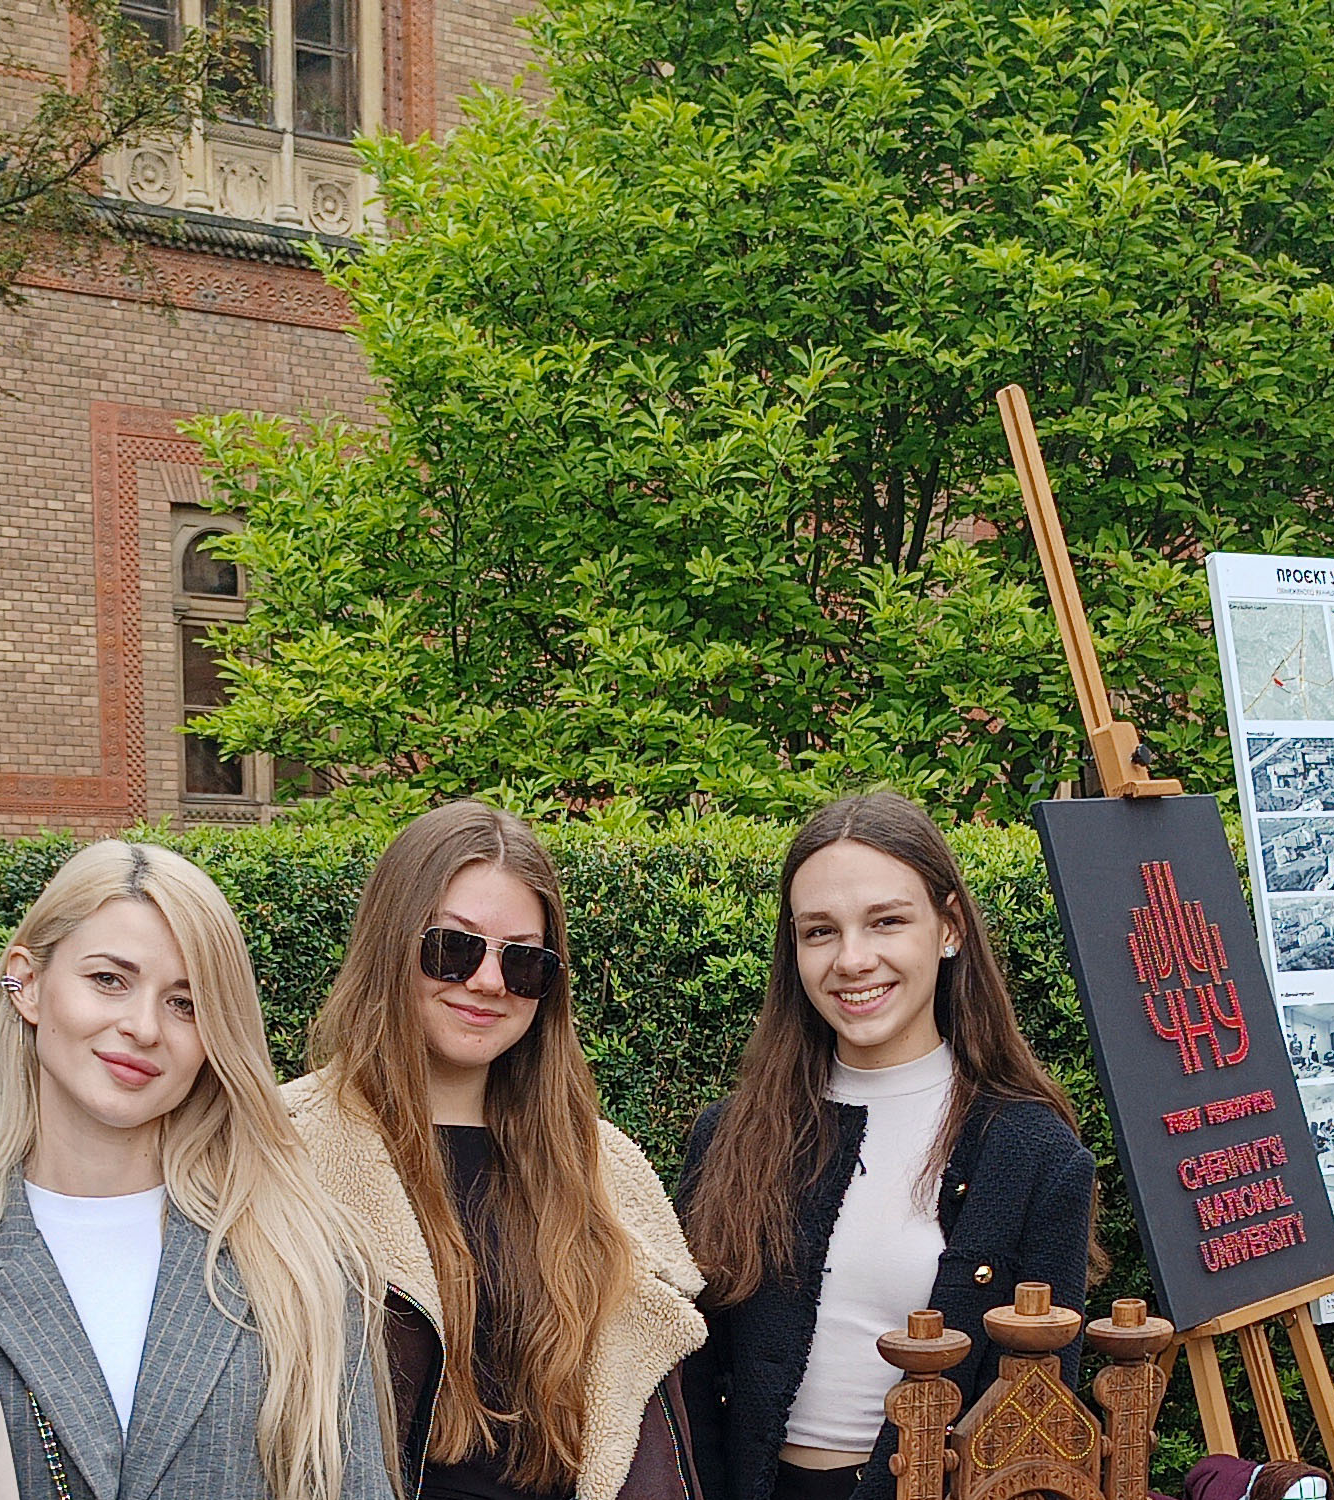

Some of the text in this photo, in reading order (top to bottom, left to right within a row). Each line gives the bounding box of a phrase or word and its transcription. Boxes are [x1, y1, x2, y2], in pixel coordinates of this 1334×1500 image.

[1276, 568, 1328, 586] ПРОЄКТ
[1195, 1175, 1294, 1231] NATIONAL
[1199, 1211, 1307, 1272] UNIVERSITY
